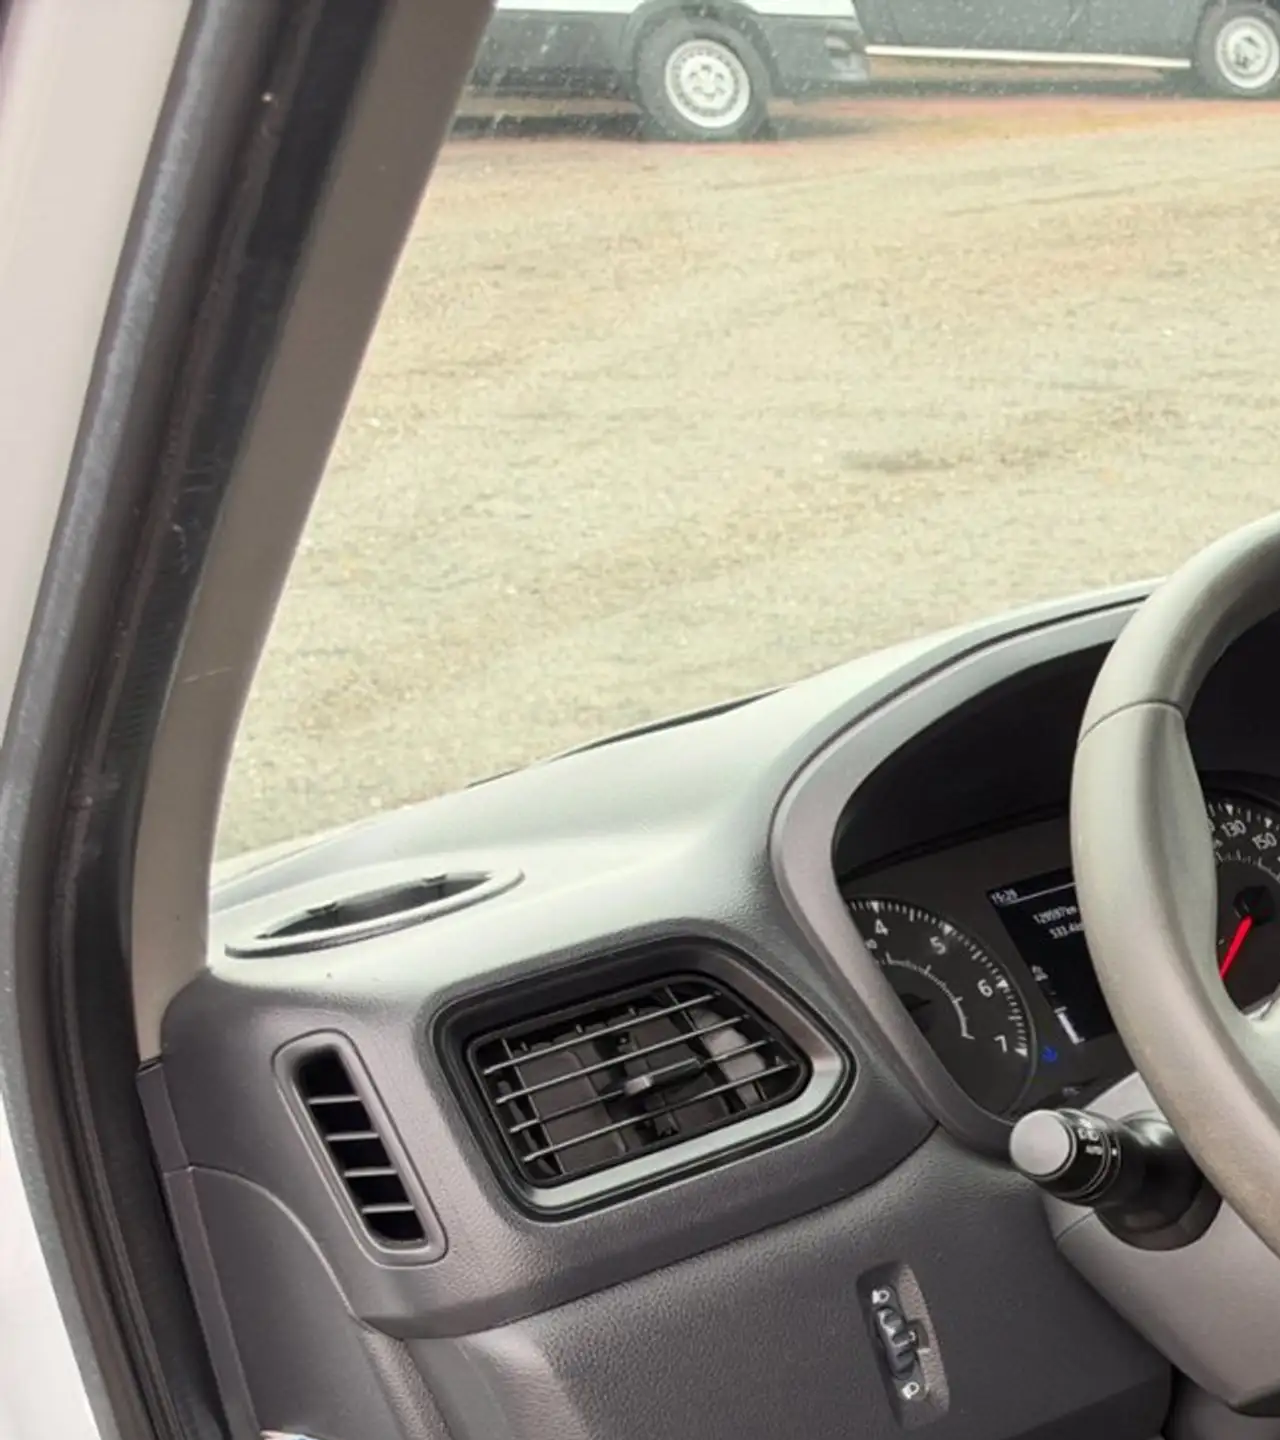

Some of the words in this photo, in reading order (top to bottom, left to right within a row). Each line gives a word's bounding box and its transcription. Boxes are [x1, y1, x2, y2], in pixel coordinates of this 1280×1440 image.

[1220, 819, 1247, 838] 130
[1252, 832, 1277, 850] 150
[874, 918, 889, 936] 4
[929, 935, 946, 955] 5
[977, 978, 994, 998] 6
[994, 1034, 1008, 1053] 7
